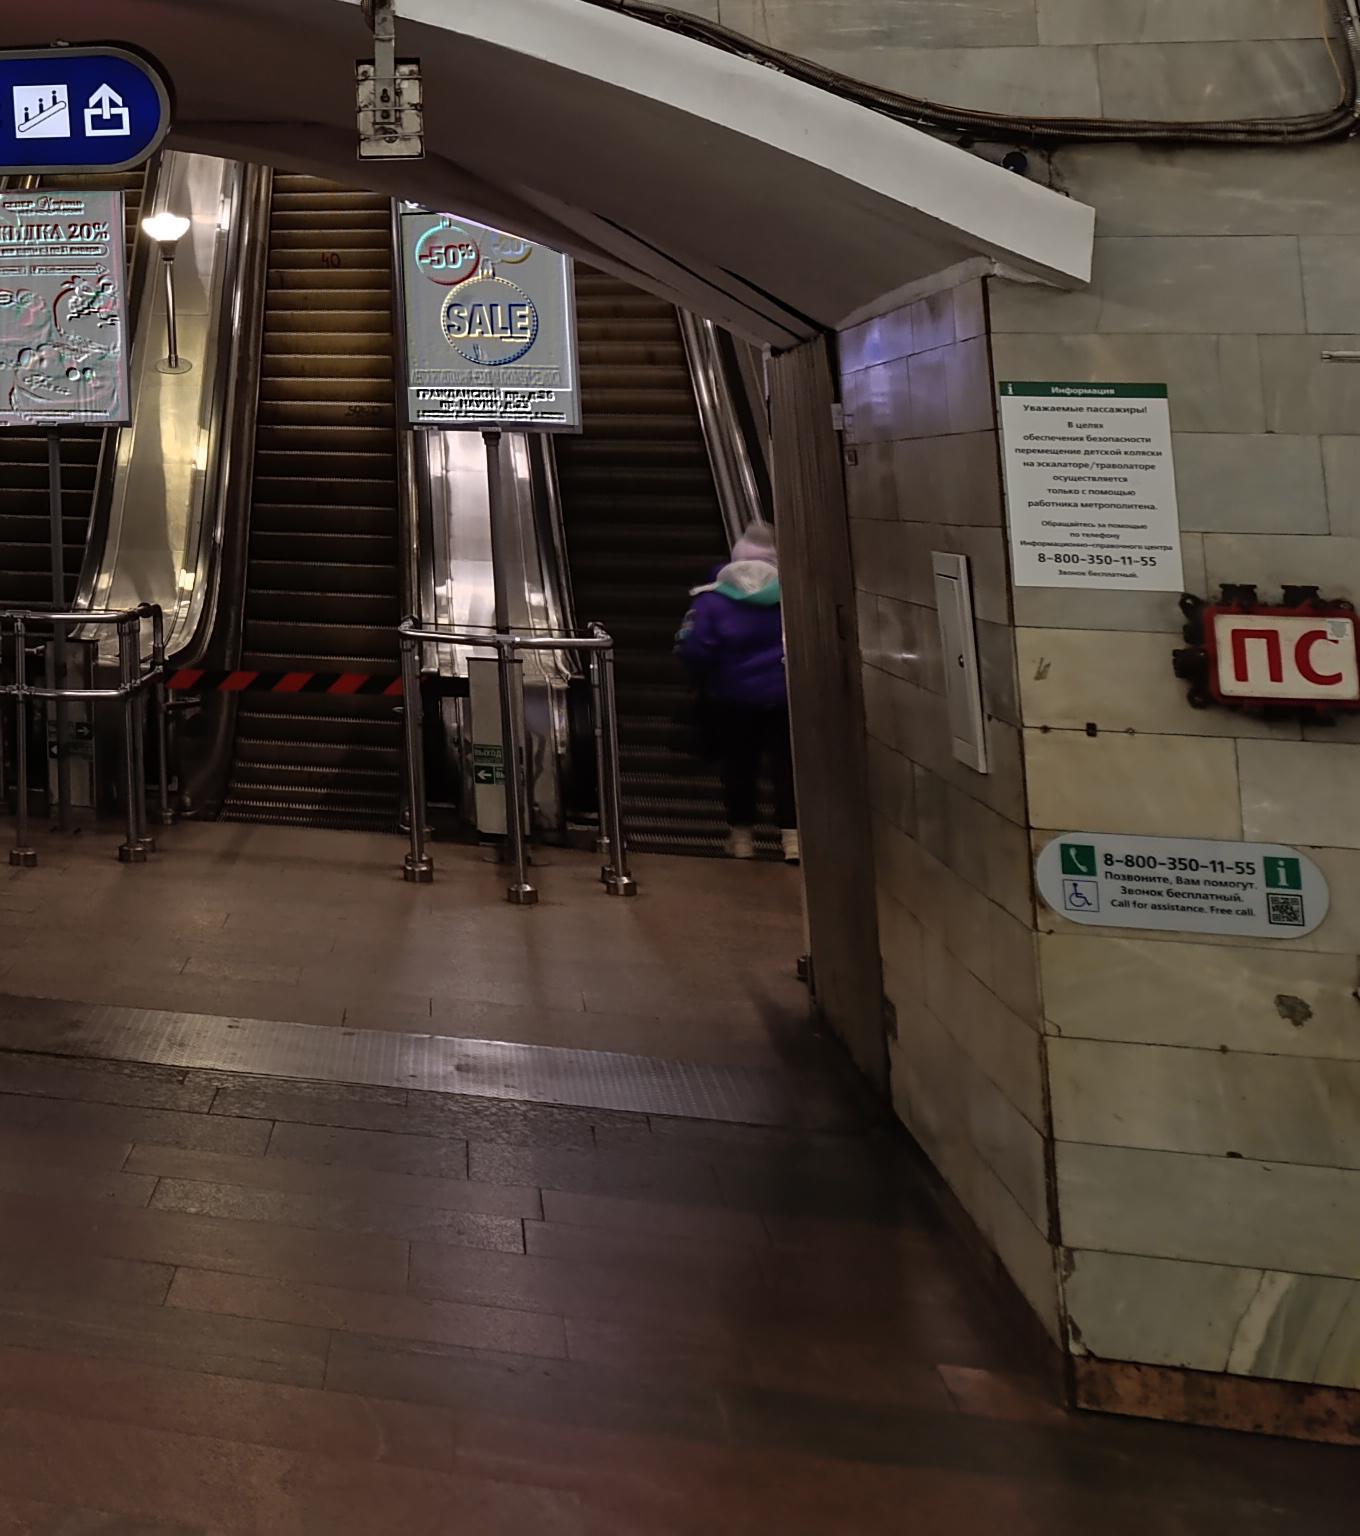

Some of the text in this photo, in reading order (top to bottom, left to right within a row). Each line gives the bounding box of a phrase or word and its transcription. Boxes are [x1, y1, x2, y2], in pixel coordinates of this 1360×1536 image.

[68, 221, 110, 242] 20%
[419, 243, 476, 268] -50%
[446, 303, 530, 338] SALE
[1051, 387, 1115, 395] Информация
[1086, 406, 1147, 415] пассажиры!
[1023, 433, 1151, 443] обеспечения безопасности
[1028, 499, 1079, 508] работника
[1038, 553, 1157, 567] 8-800-350-11-55
[1231, 629, 1343, 686] ПС
[1103, 853, 1256, 875] 8-800-350-11-55
[1105, 871, 1257, 890] Позвоните, Вам помогут.
[1120, 885, 1243, 902] Звонок бесплатный.
[1110, 899, 1255, 916] Call for assistance. Free call.
